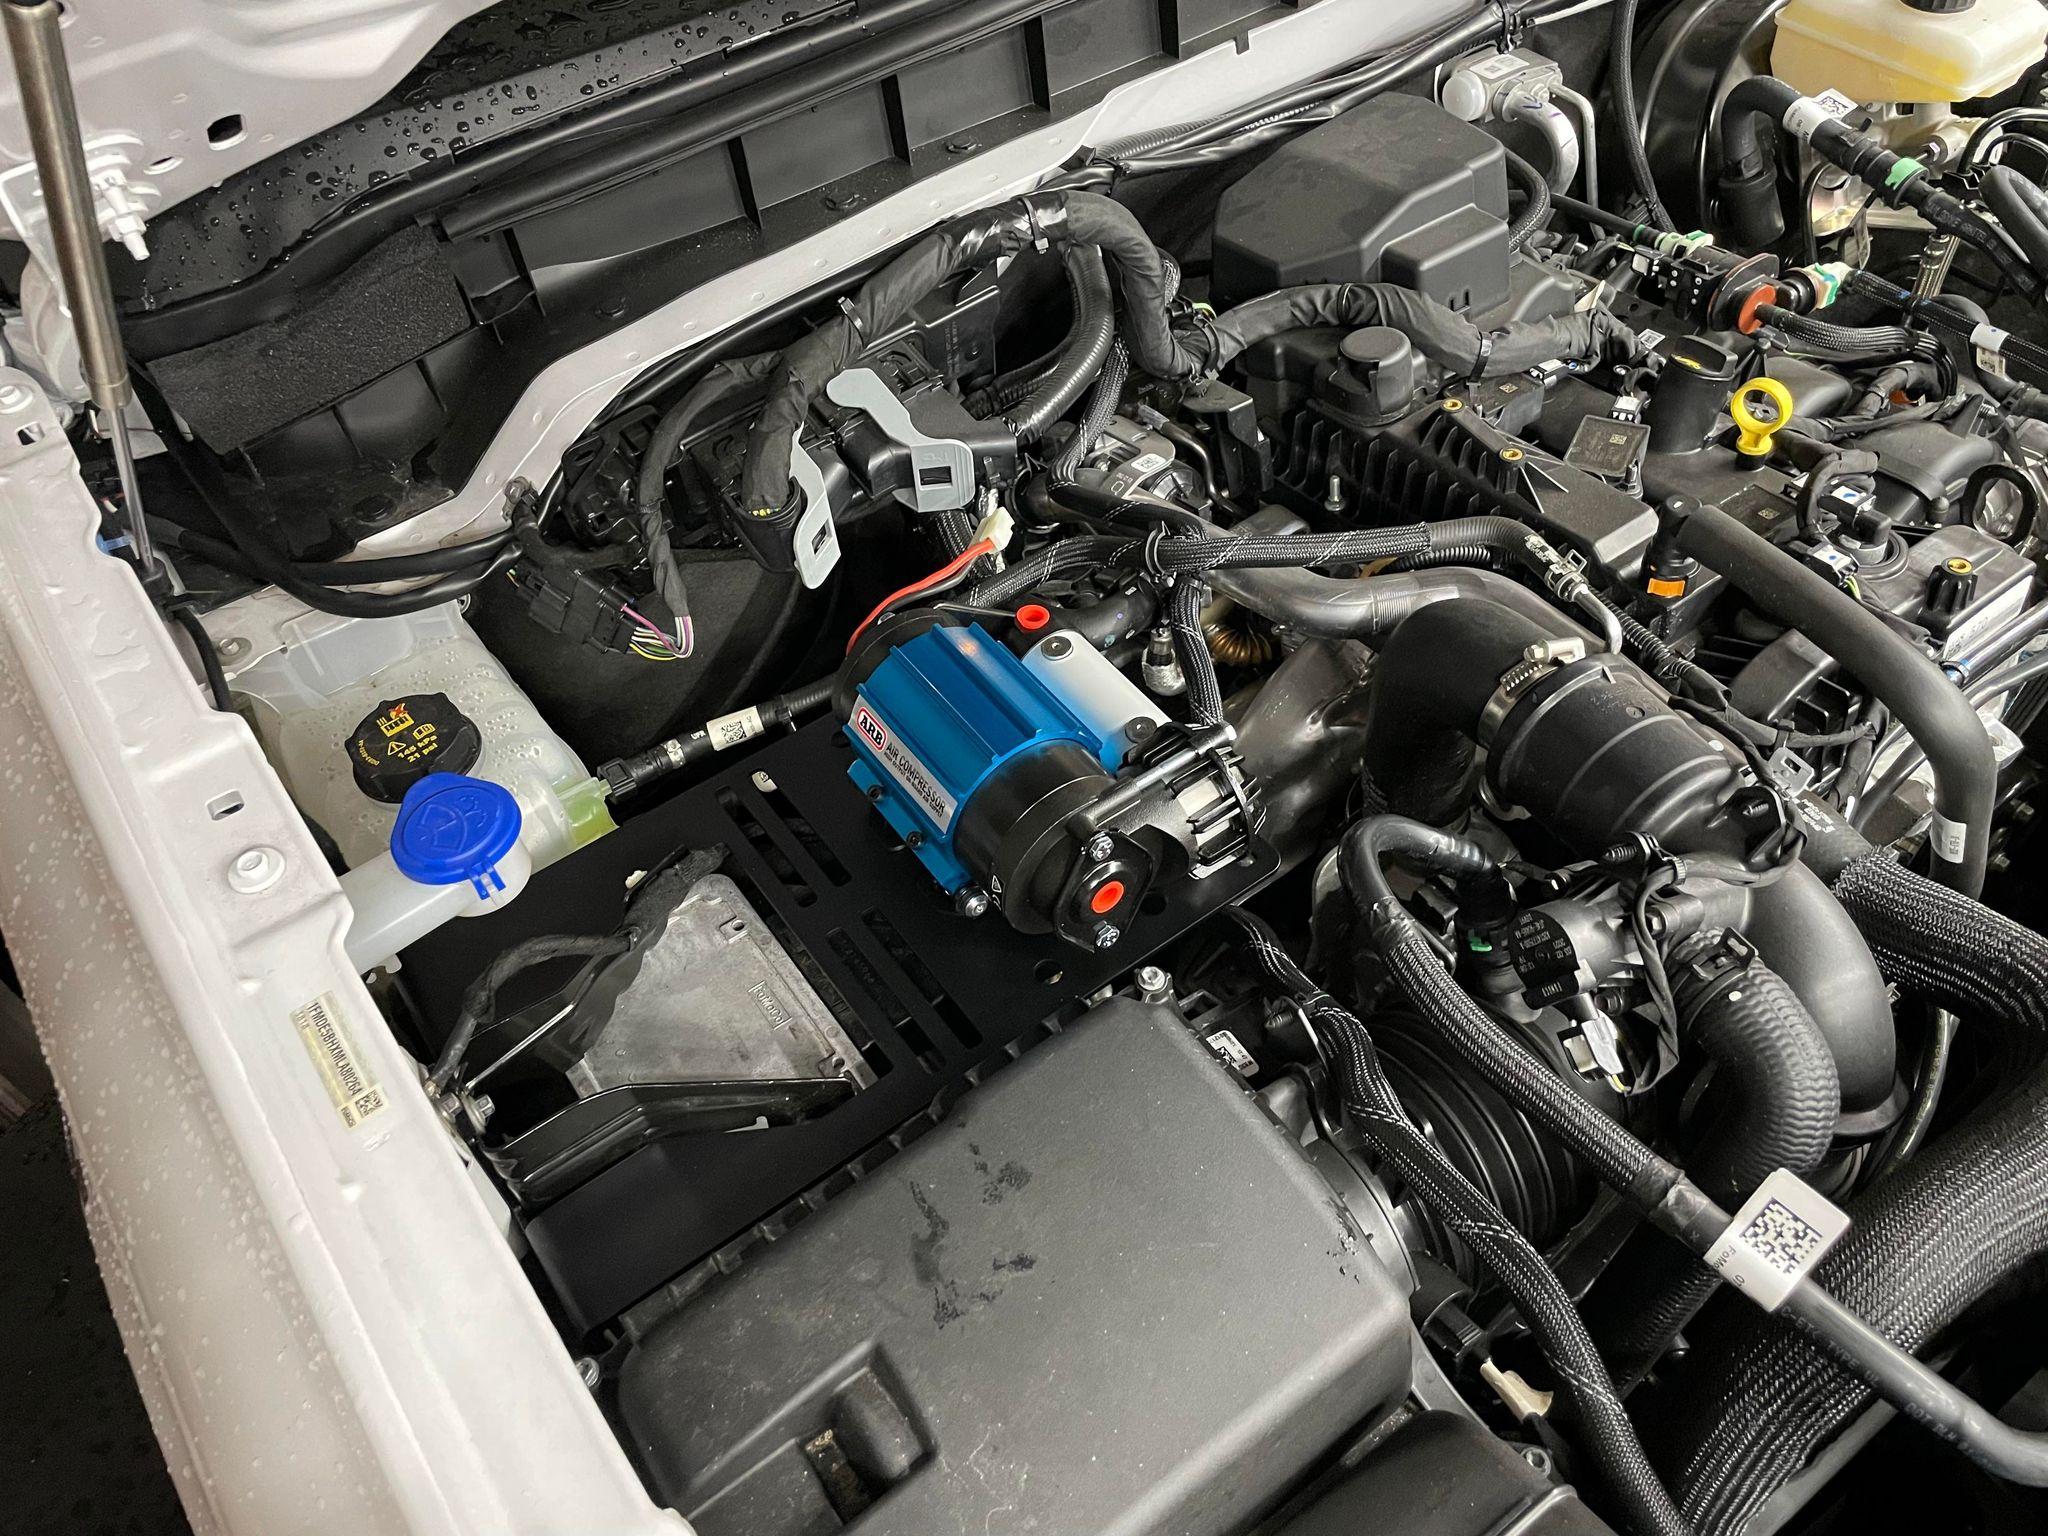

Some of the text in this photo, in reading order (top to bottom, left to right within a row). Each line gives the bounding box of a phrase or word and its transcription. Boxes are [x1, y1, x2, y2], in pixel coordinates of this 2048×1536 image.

[859, 714, 884, 746] ARB
[398, 745, 417, 759] 145
[407, 752, 421, 763] 21
[886, 742, 946, 813] AIR COMPRESSOR
